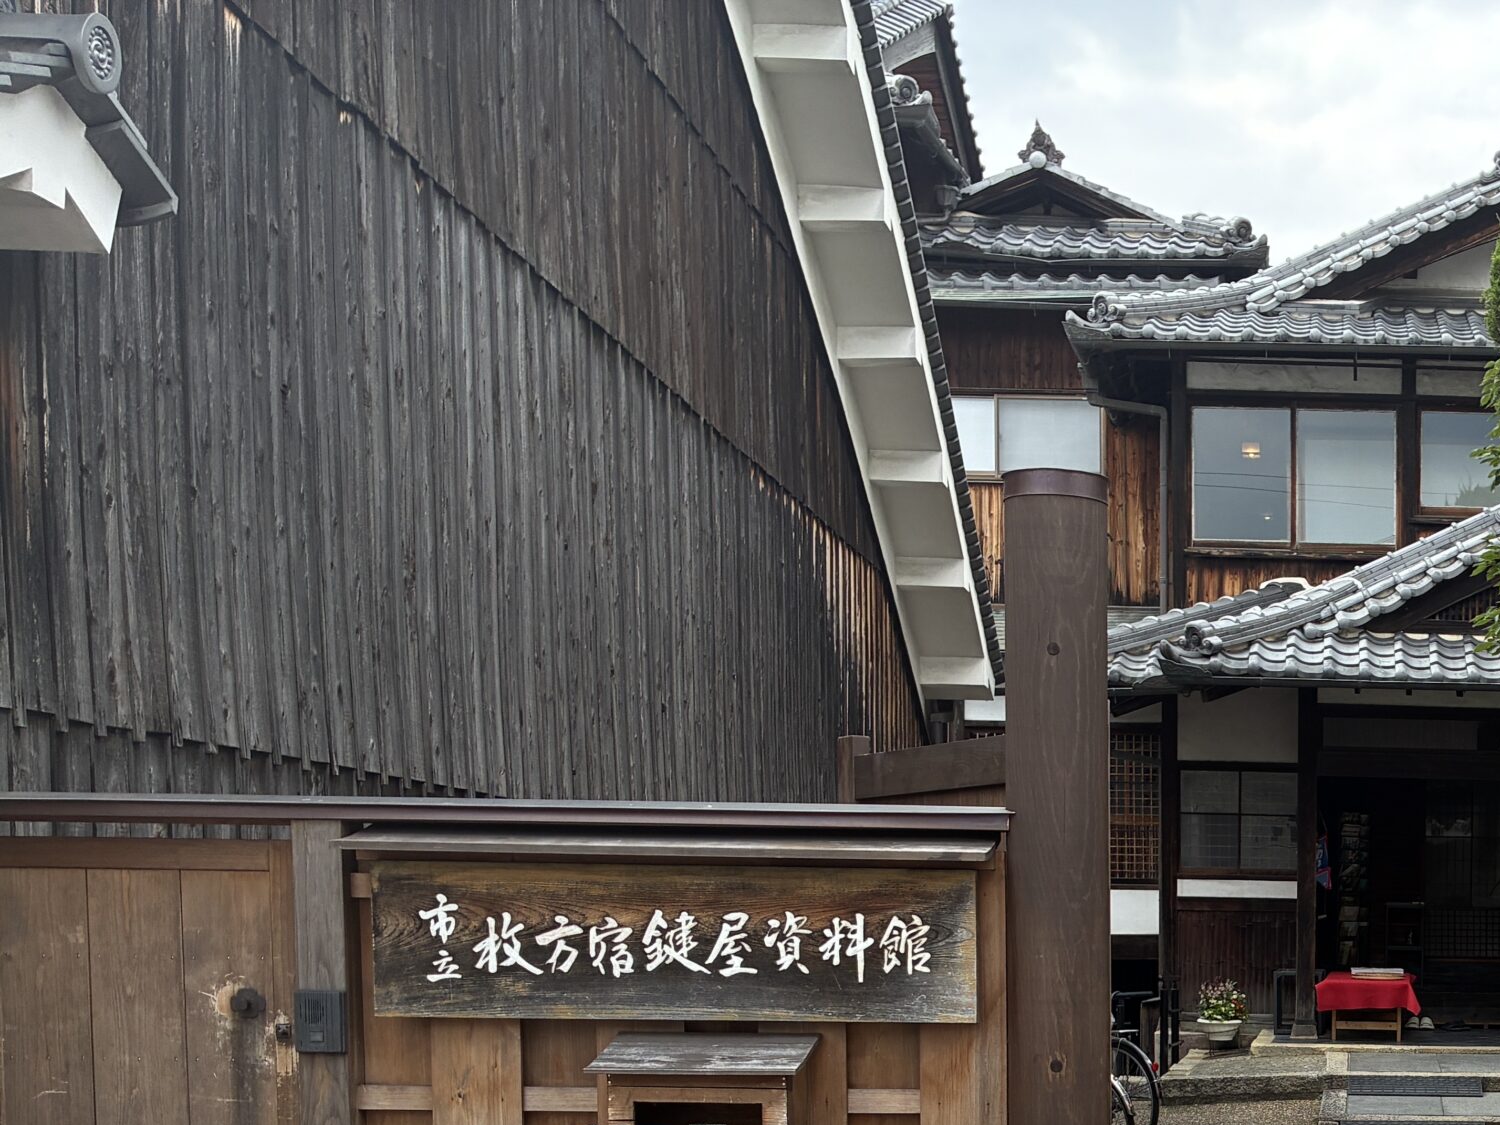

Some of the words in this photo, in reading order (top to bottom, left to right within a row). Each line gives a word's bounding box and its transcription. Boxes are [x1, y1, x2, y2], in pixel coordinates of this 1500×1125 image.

[418, 893, 462, 983] 市立
[473, 909, 932, 983] 枚方宿鍵屋資料館
